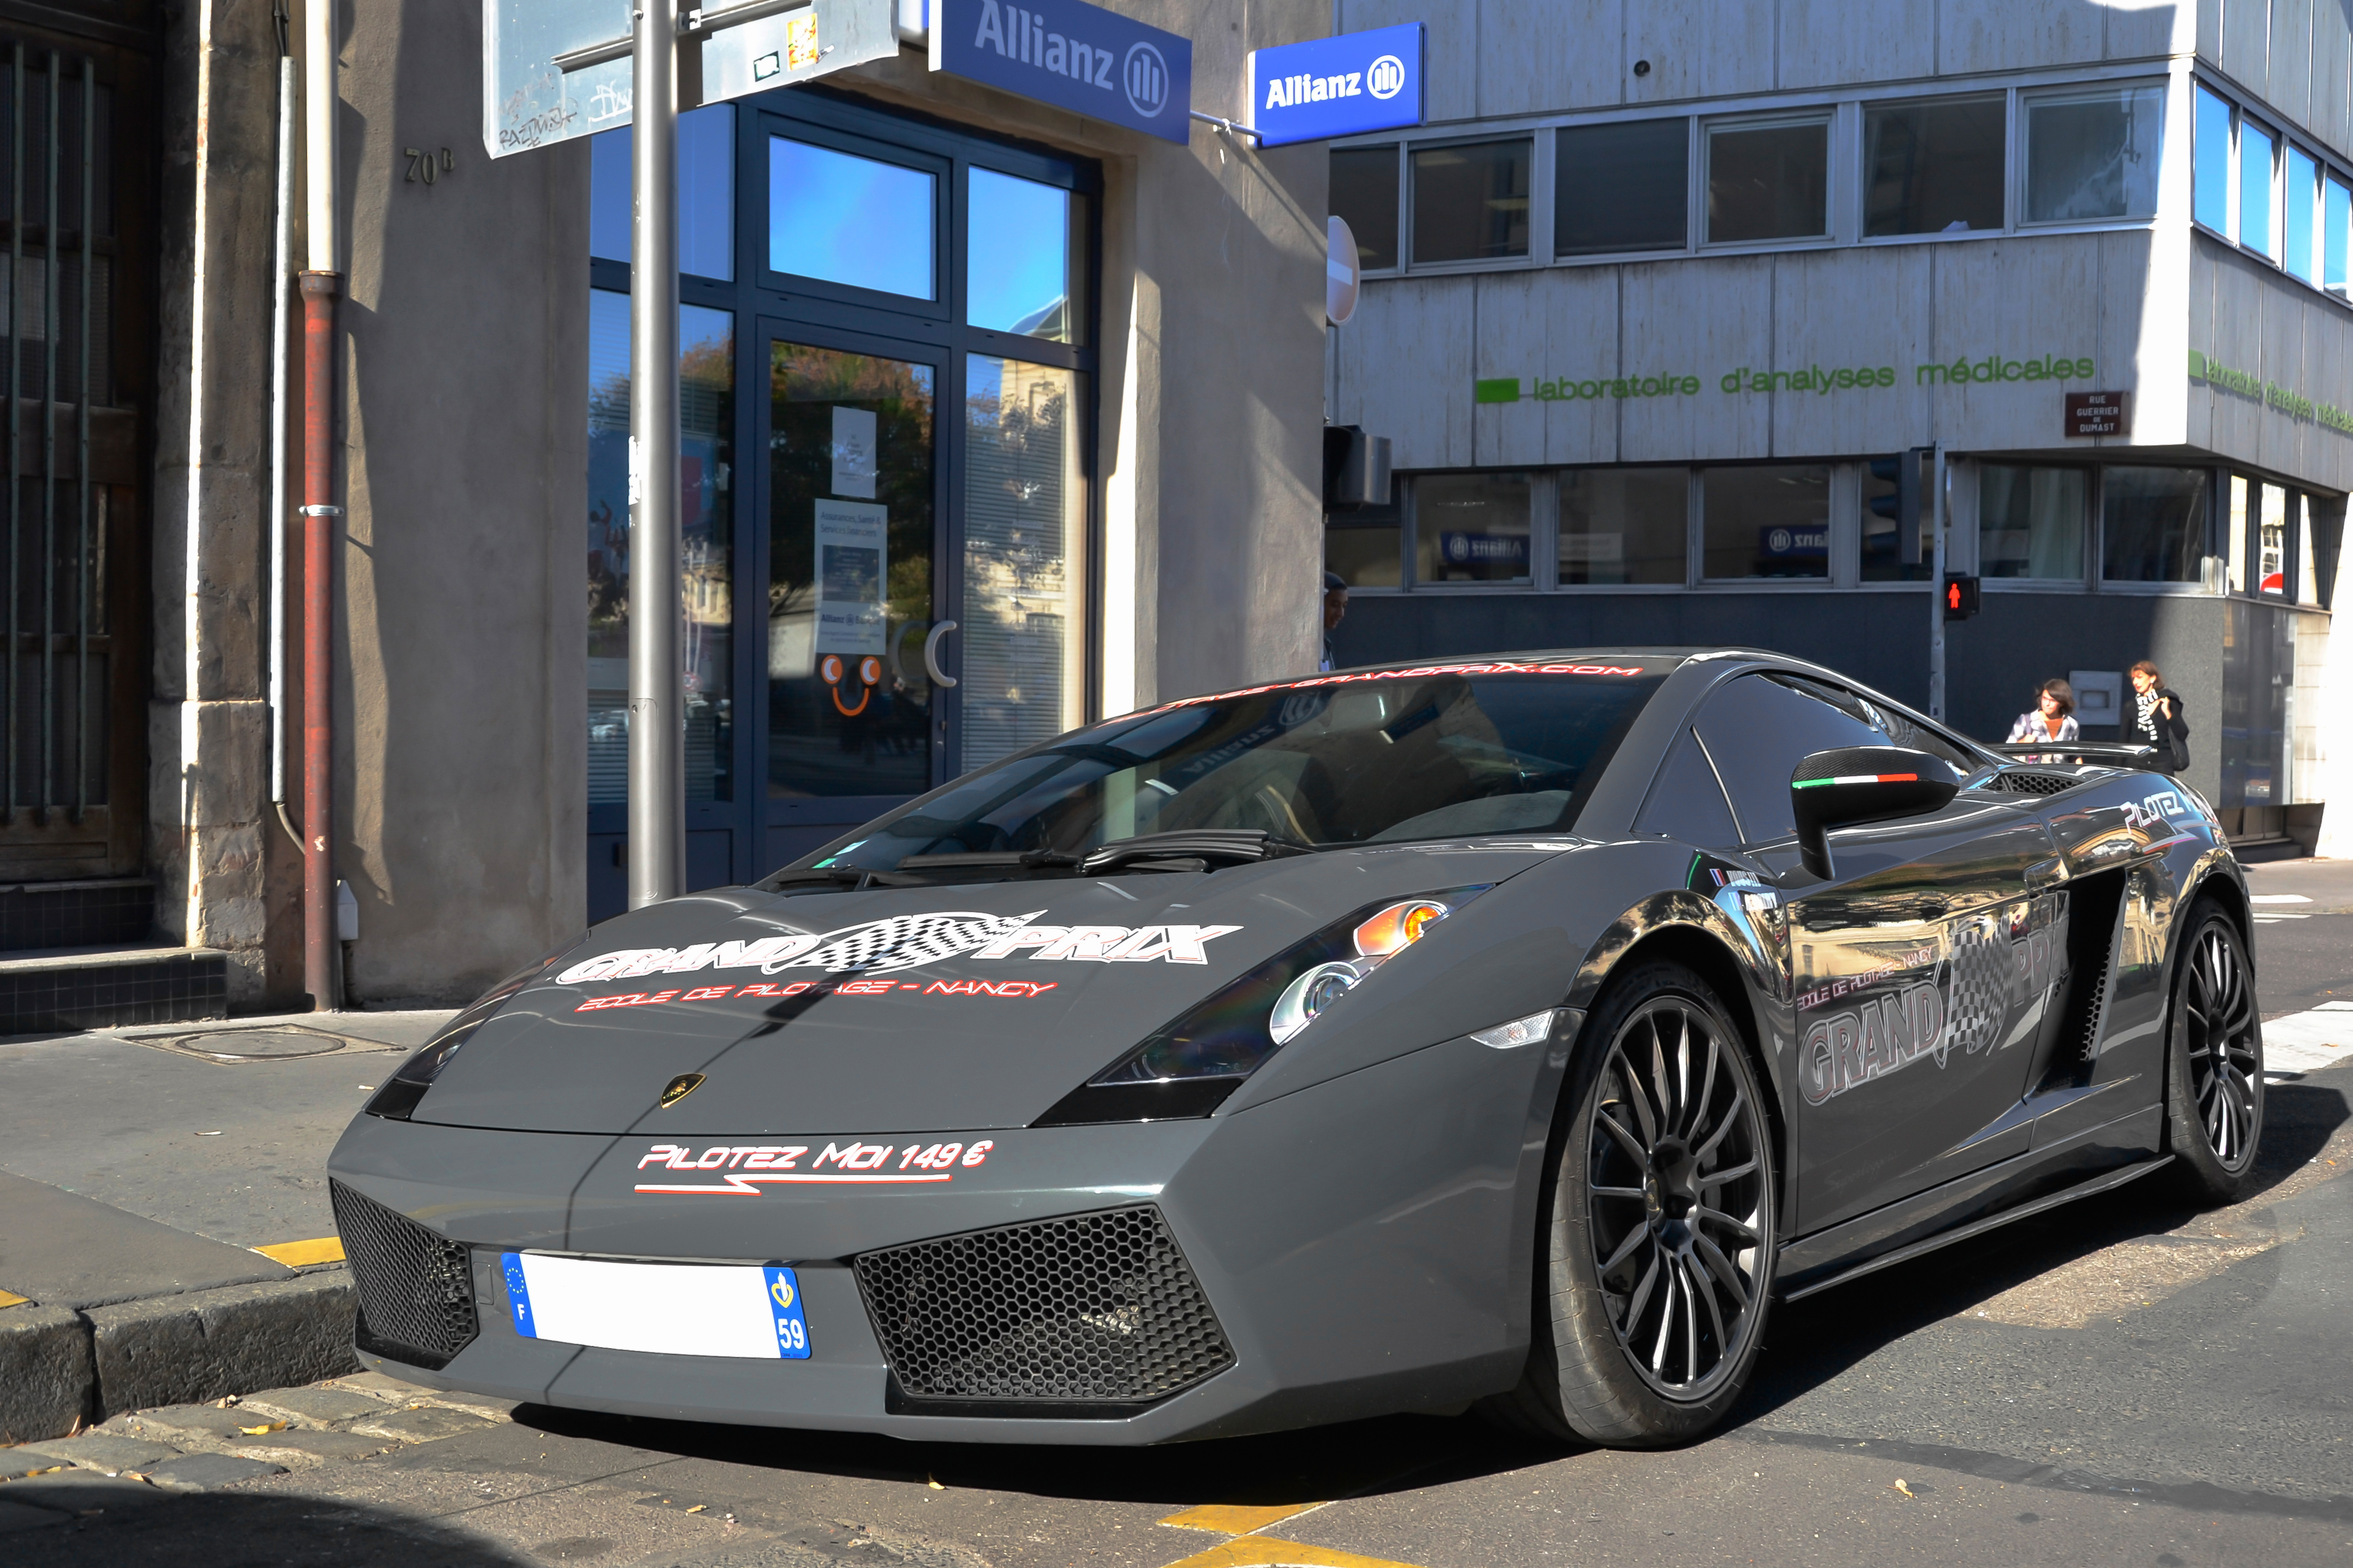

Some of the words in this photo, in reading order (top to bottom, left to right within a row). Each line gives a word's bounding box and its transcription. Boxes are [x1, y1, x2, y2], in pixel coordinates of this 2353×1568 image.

[974, 0, 1114, 92] Allianz
[1265, 72, 1361, 110] Allianz
[1533, 371, 1701, 402] laboratoire
[1721, 363, 1896, 397] d'analyses
[1917, 354, 2095, 385] médicales
[2206, 356, 2261, 399] laboratoire
[2265, 380, 2313, 419] d'analyses
[2316, 401, 2353, 434] médicale
[2076, 406, 2119, 416] GUERRIER
[2089, 395, 2106, 404] RUE
[2080, 423, 2115, 433] DUMAST
[821, 614, 845, 623] Allianz
[2120, 791, 2184, 835] PILOTEZ
[556, 934, 821, 984] GRAND
[970, 925, 1245, 965] PRIX
[1832, 980, 1848, 1000] DE
[1902, 947, 1932, 969] NANCY
[574, 989, 682, 1013] ECOLE
[679, 984, 737, 1002] DE
[733, 979, 900, 999] PILOTAGE
[923, 980, 1059, 998] NANCY
[1801, 980, 1944, 1106] GRAND
[637, 1144, 808, 1170] PILOTEZ
[813, 1141, 894, 1170] MOI
[899, 1142, 963, 1170] 149
[517, 1303, 525, 1321] F
[778, 1318, 805, 1350] 59
